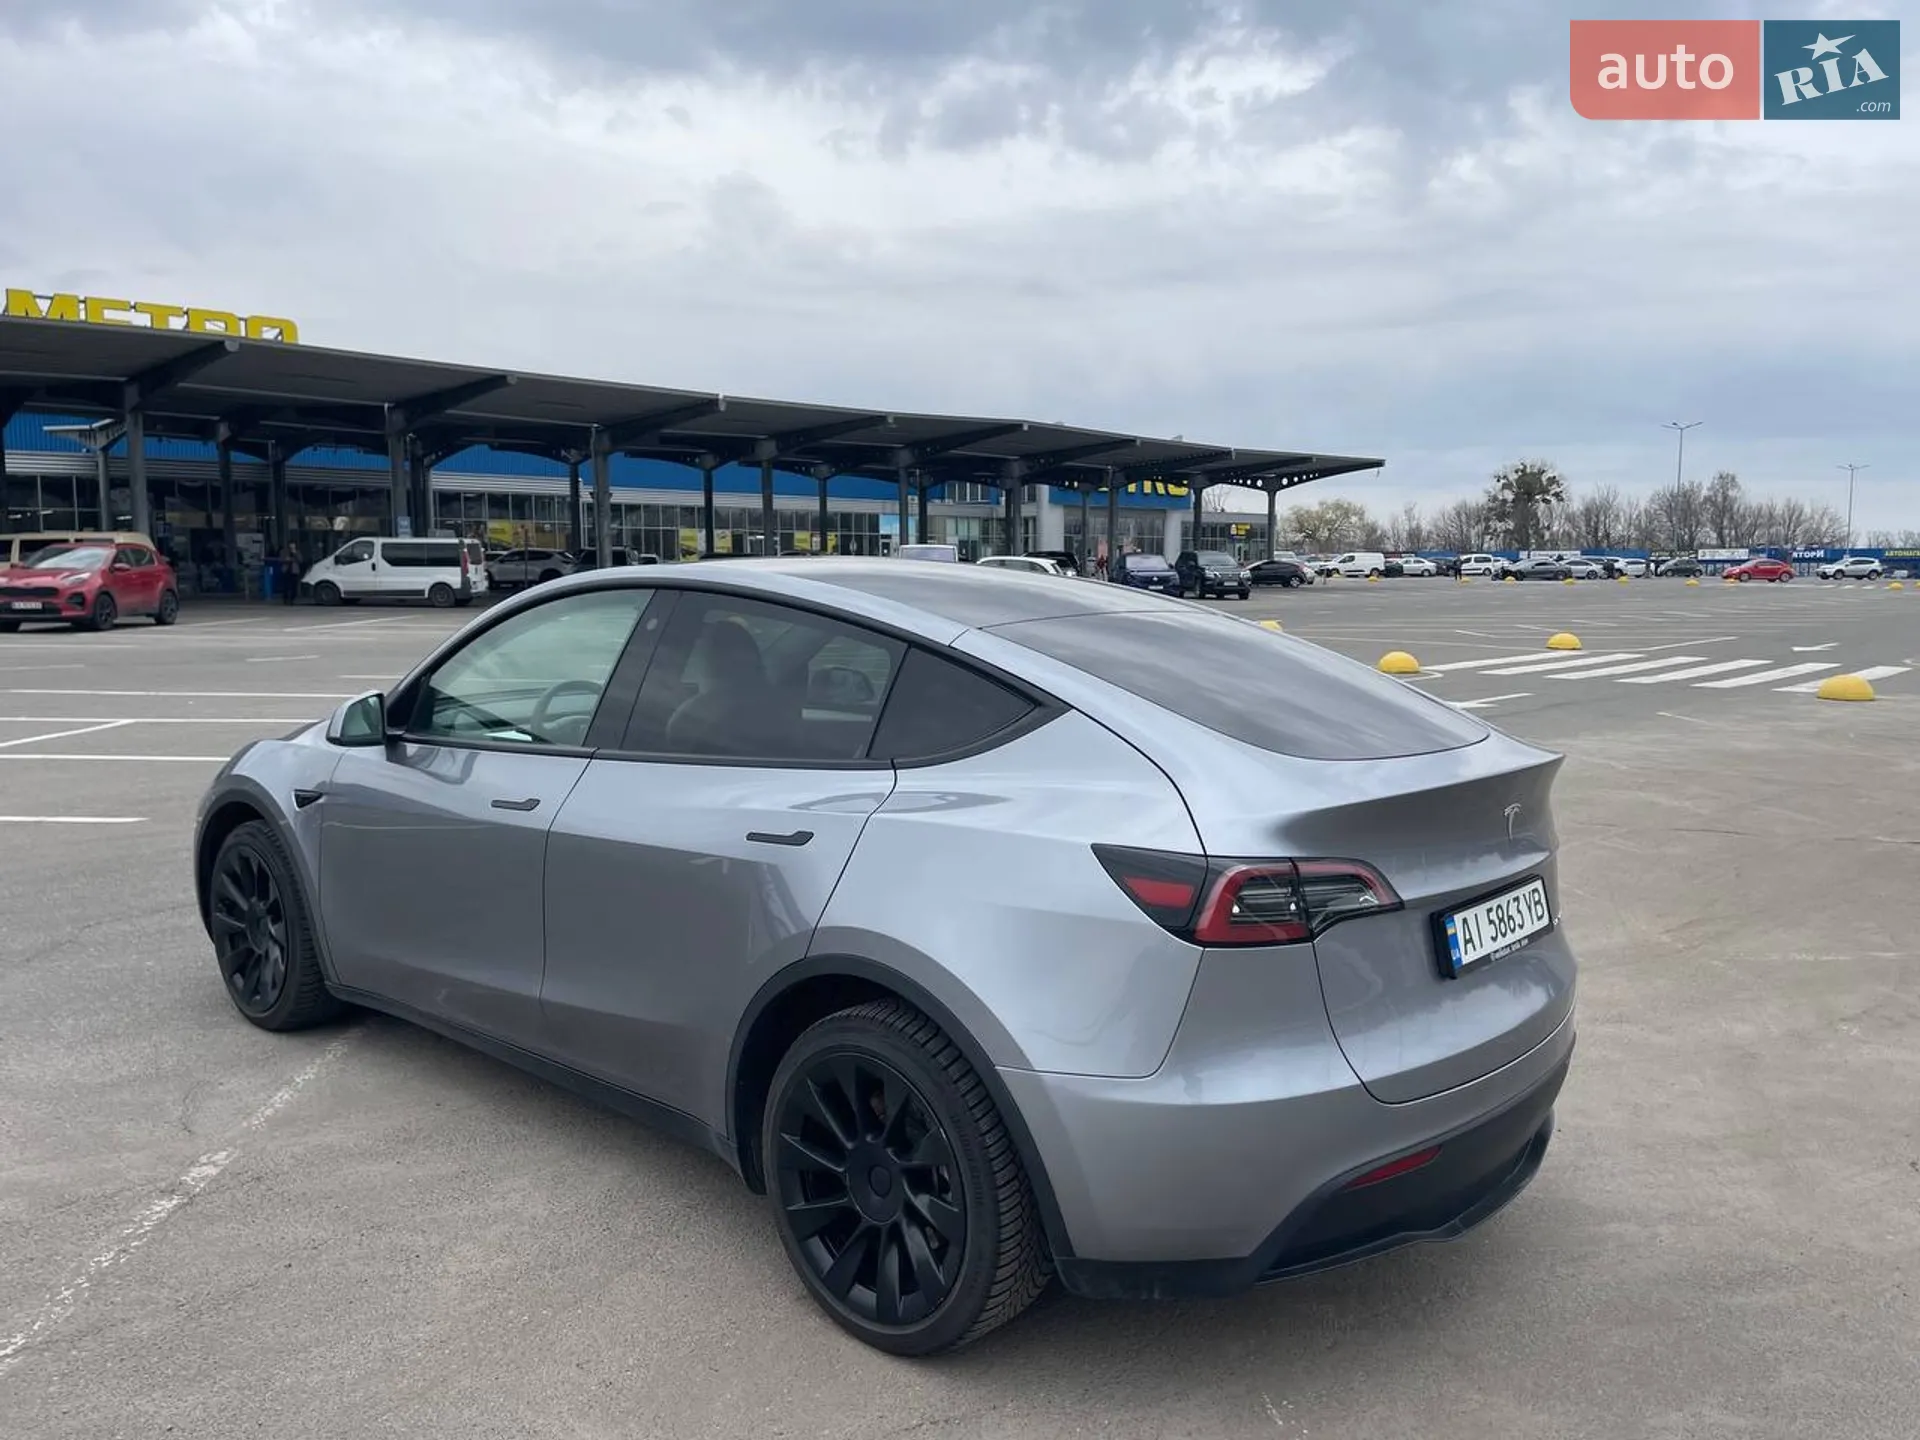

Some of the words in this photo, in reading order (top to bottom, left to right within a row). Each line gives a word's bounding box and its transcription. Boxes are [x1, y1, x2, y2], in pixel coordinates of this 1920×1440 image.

[1462, 913, 1483, 955] AI
[1486, 895, 1524, 943] 5863
[1523, 888, 1545, 925] YB
